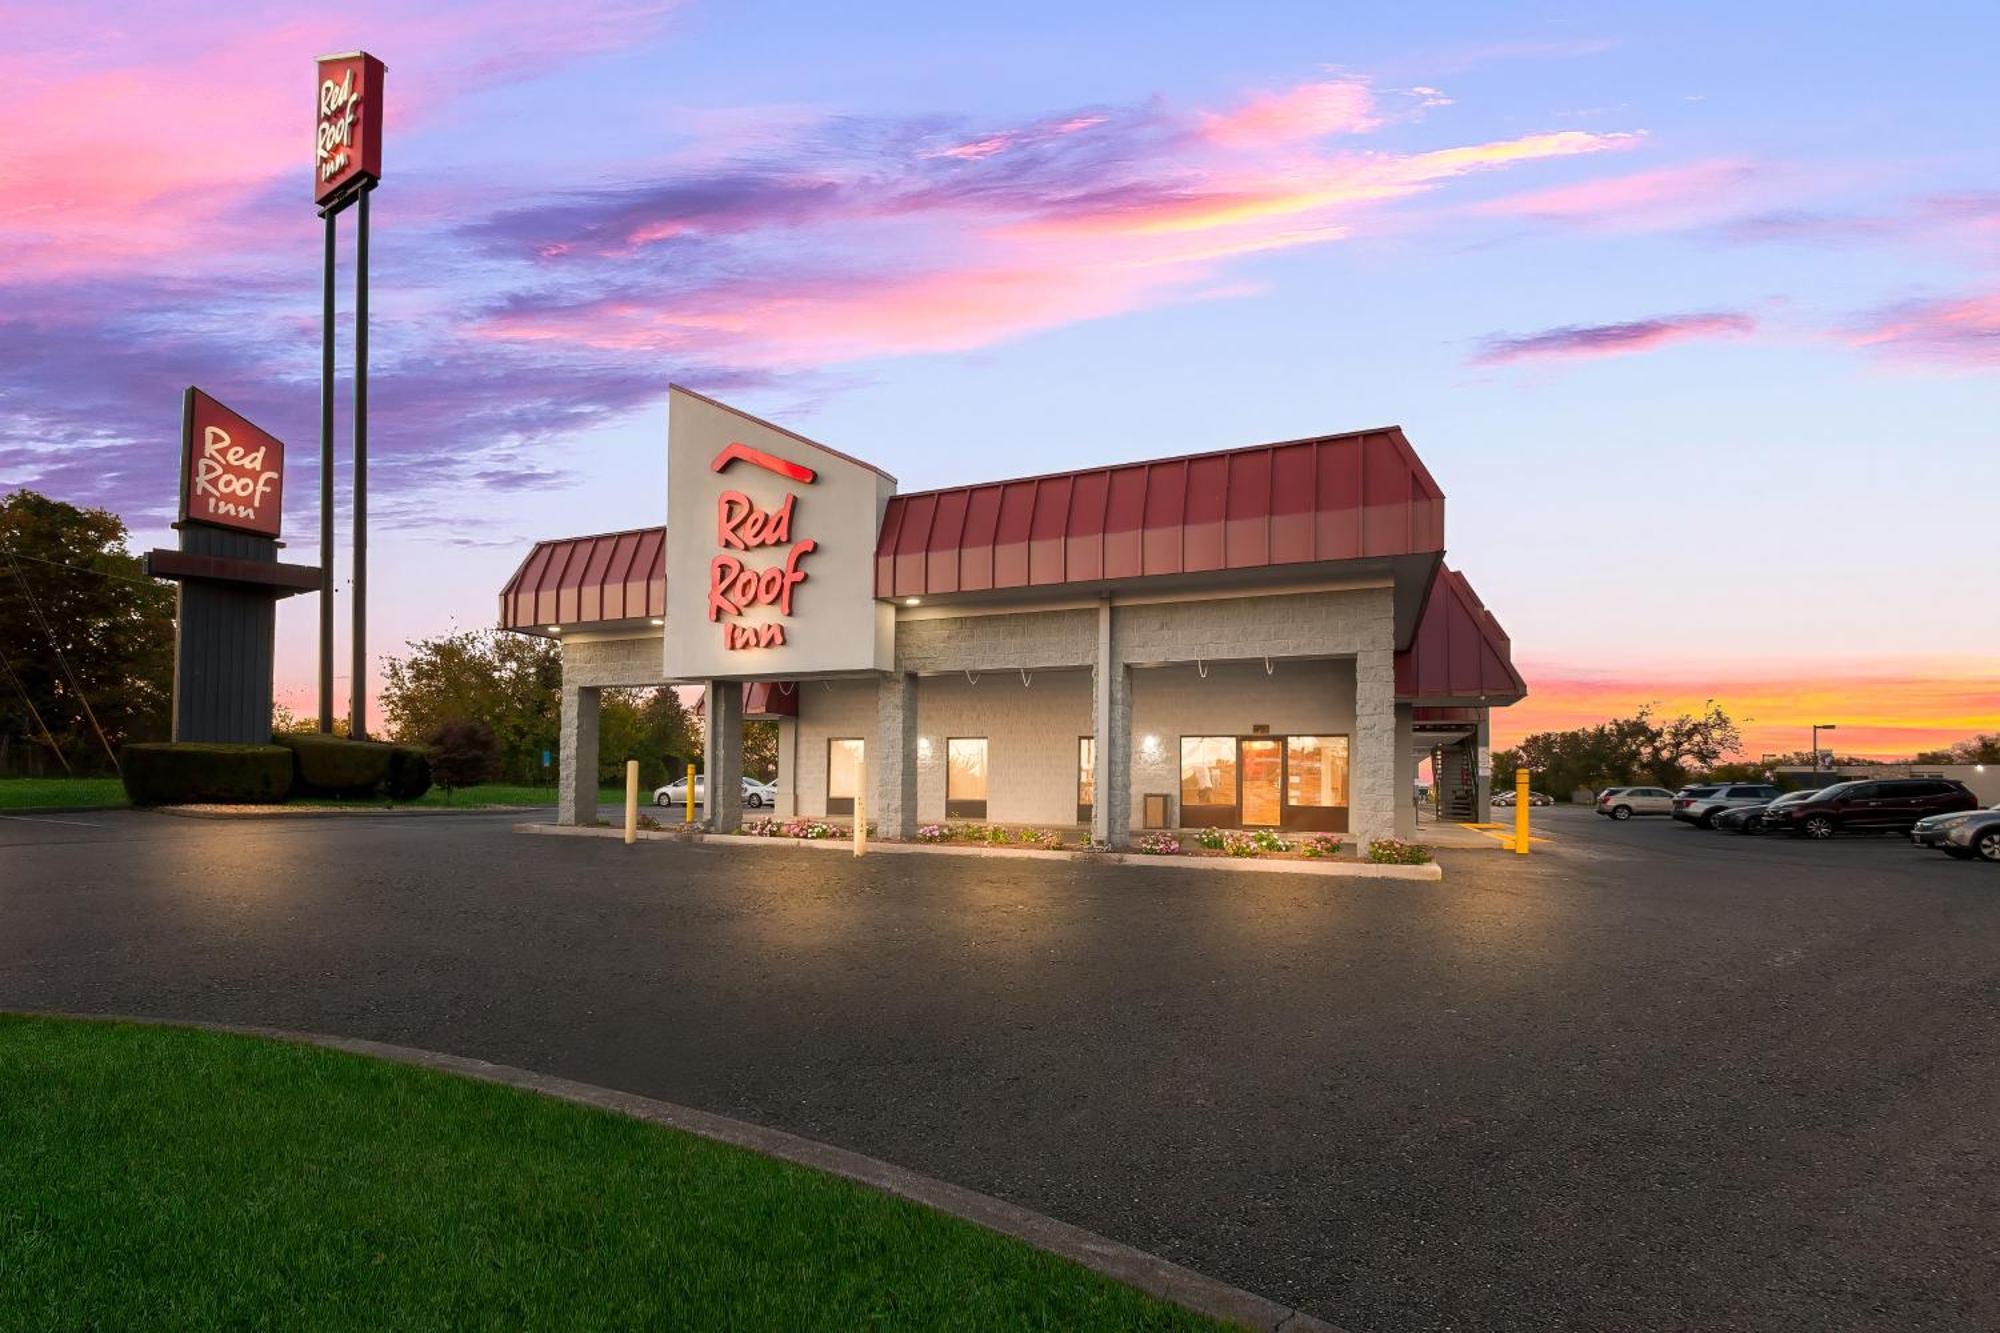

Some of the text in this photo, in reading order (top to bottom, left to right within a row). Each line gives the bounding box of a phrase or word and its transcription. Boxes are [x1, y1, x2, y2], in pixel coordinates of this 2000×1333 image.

[321, 69, 353, 118] Red
[317, 93, 358, 167] Roof
[204, 426, 266, 471] Red
[196, 458, 279, 507] Roof
[719, 489, 798, 550] Red
[708, 538, 817, 622] Roof
